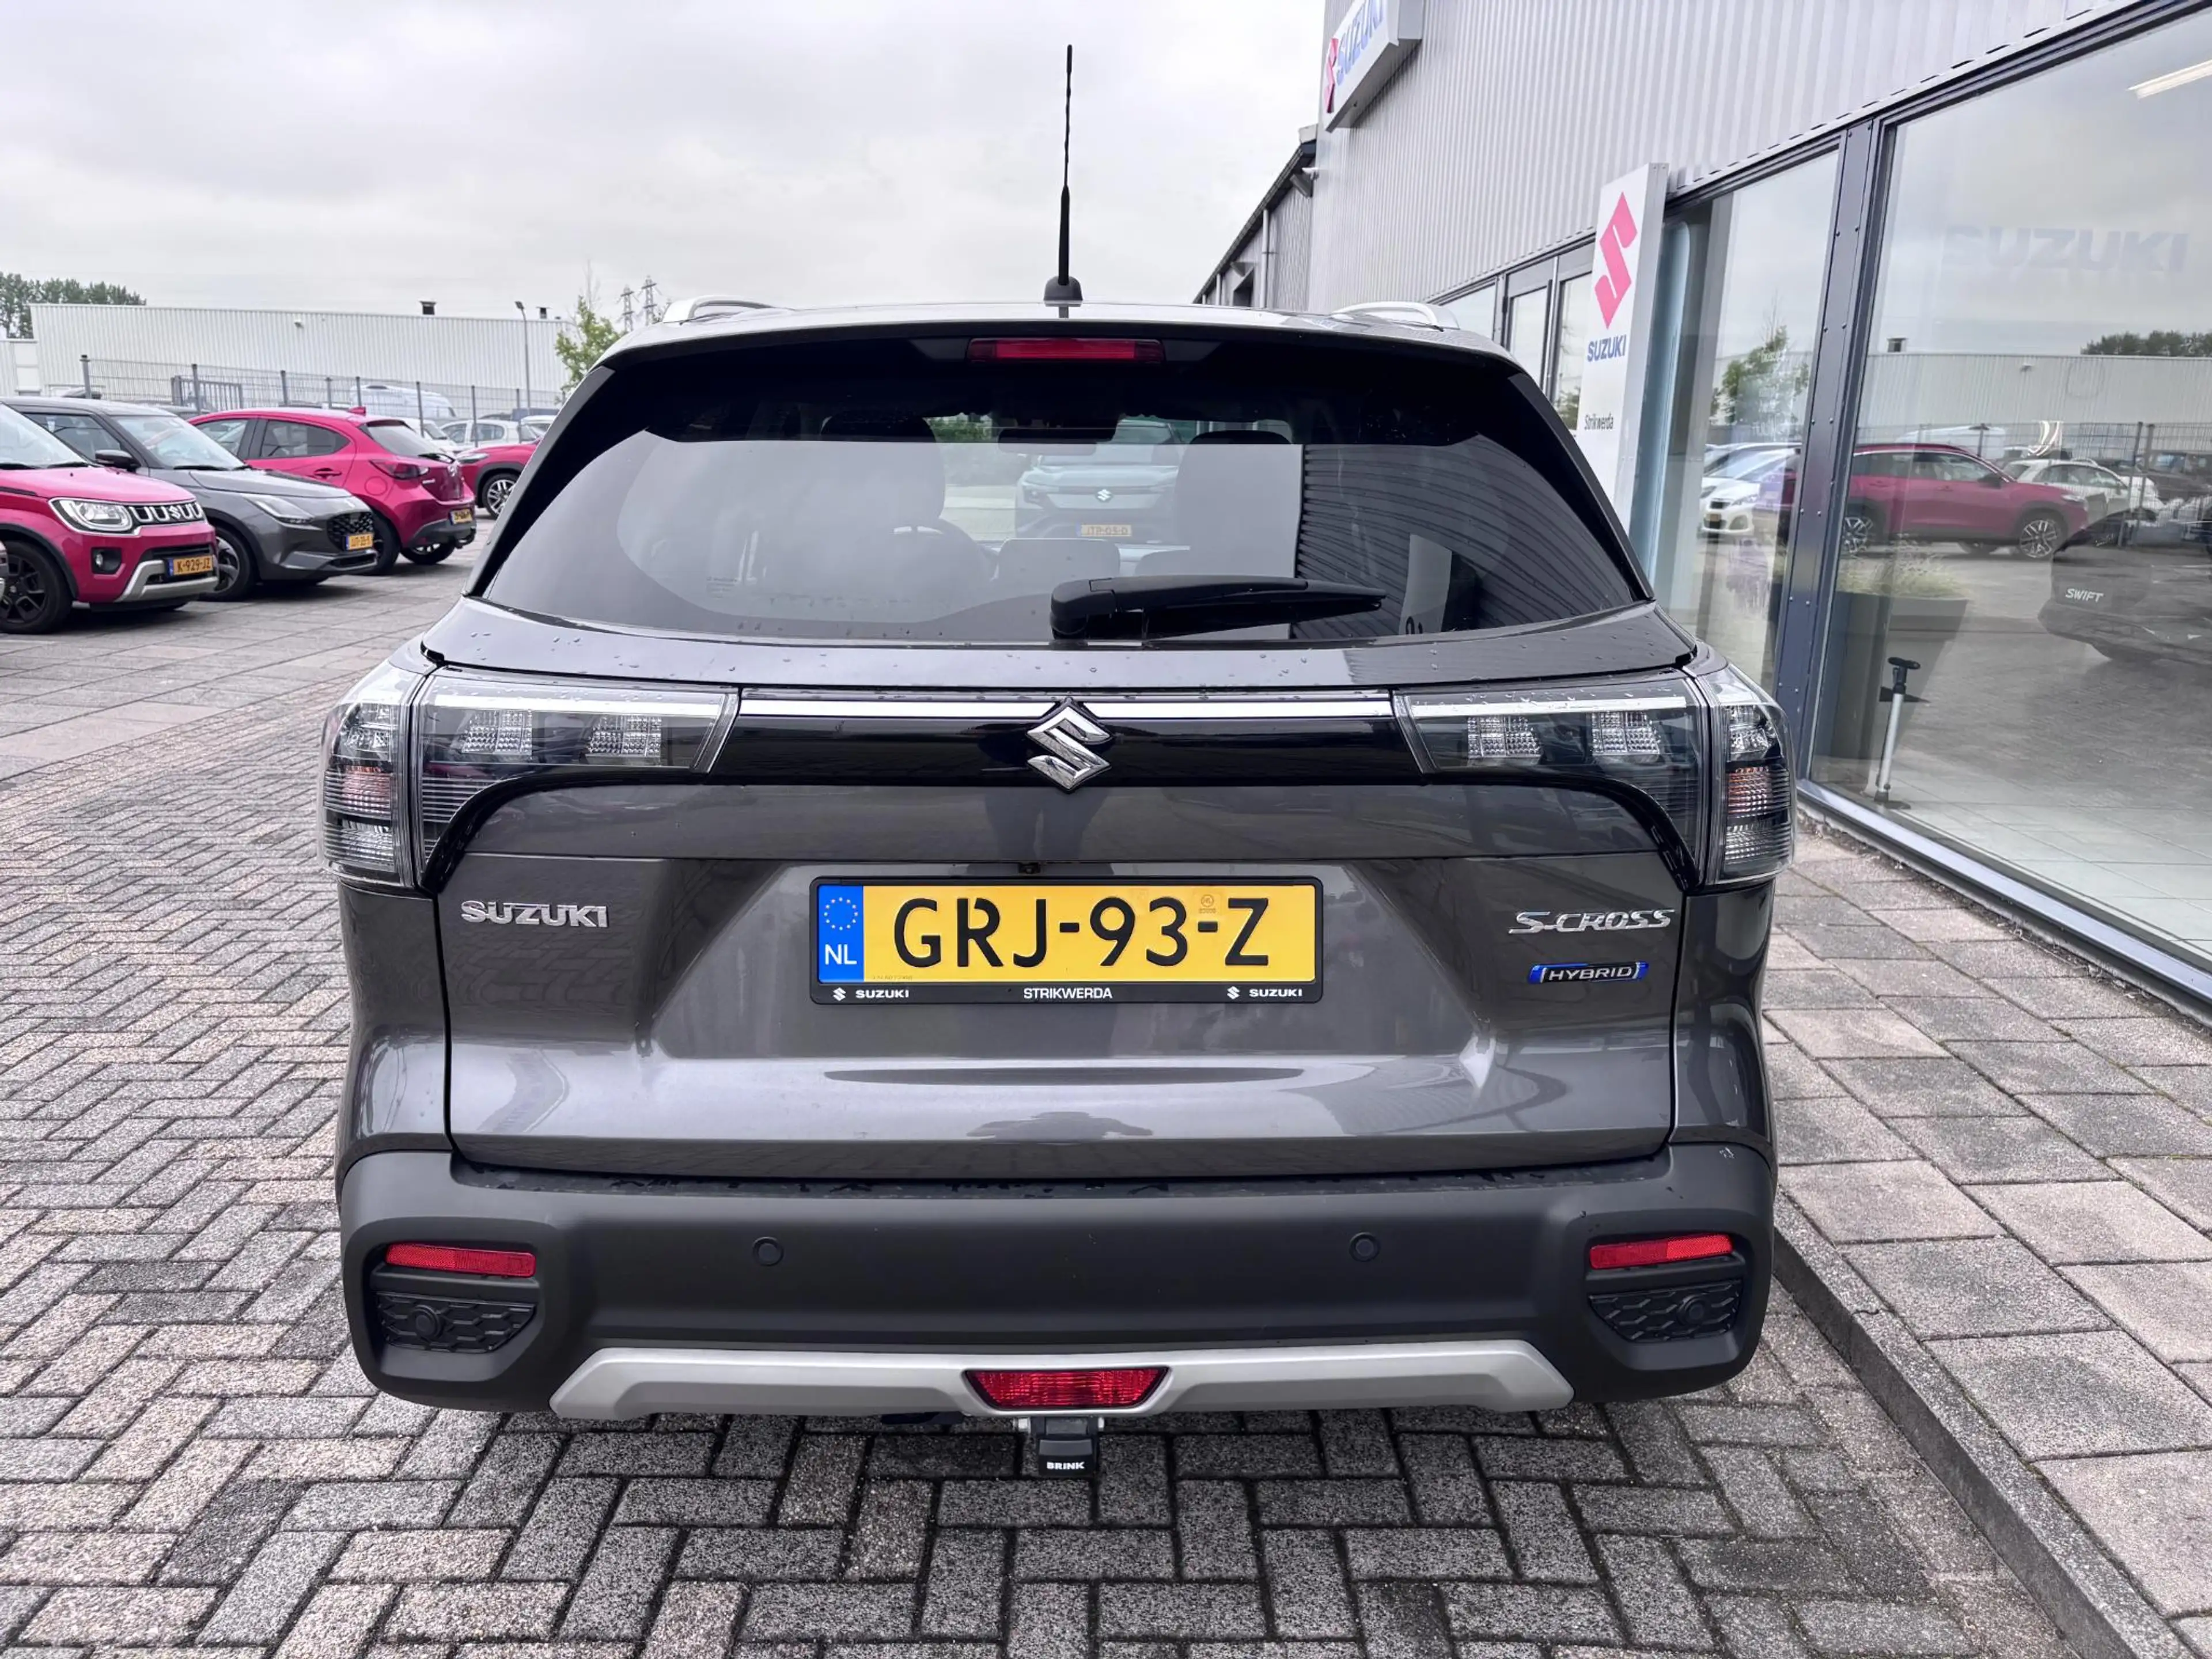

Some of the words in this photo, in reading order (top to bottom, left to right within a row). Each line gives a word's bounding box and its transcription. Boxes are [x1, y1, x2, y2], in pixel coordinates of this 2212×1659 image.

[1941, 224, 2189, 273] SUZUKI
[1587, 334, 1627, 362] SUZUKI
[1584, 411, 1614, 431] Strikwerda
[176, 557, 211, 573] K-929-JZ
[2065, 588, 2104, 603] SWIFT
[461, 900, 608, 928] SUZUKI
[1508, 909, 1675, 934] S-CROSS
[894, 897, 1269, 968] GRJ-93-Z
[824, 944, 857, 965] NL
[1548, 966, 1633, 981] HYBRID
[855, 988, 910, 999] SUZUKI
[1023, 987, 1113, 999] STRIKWERDA
[1249, 988, 1303, 998] SUZUKI
[1046, 1461, 1085, 1470] BRINK
